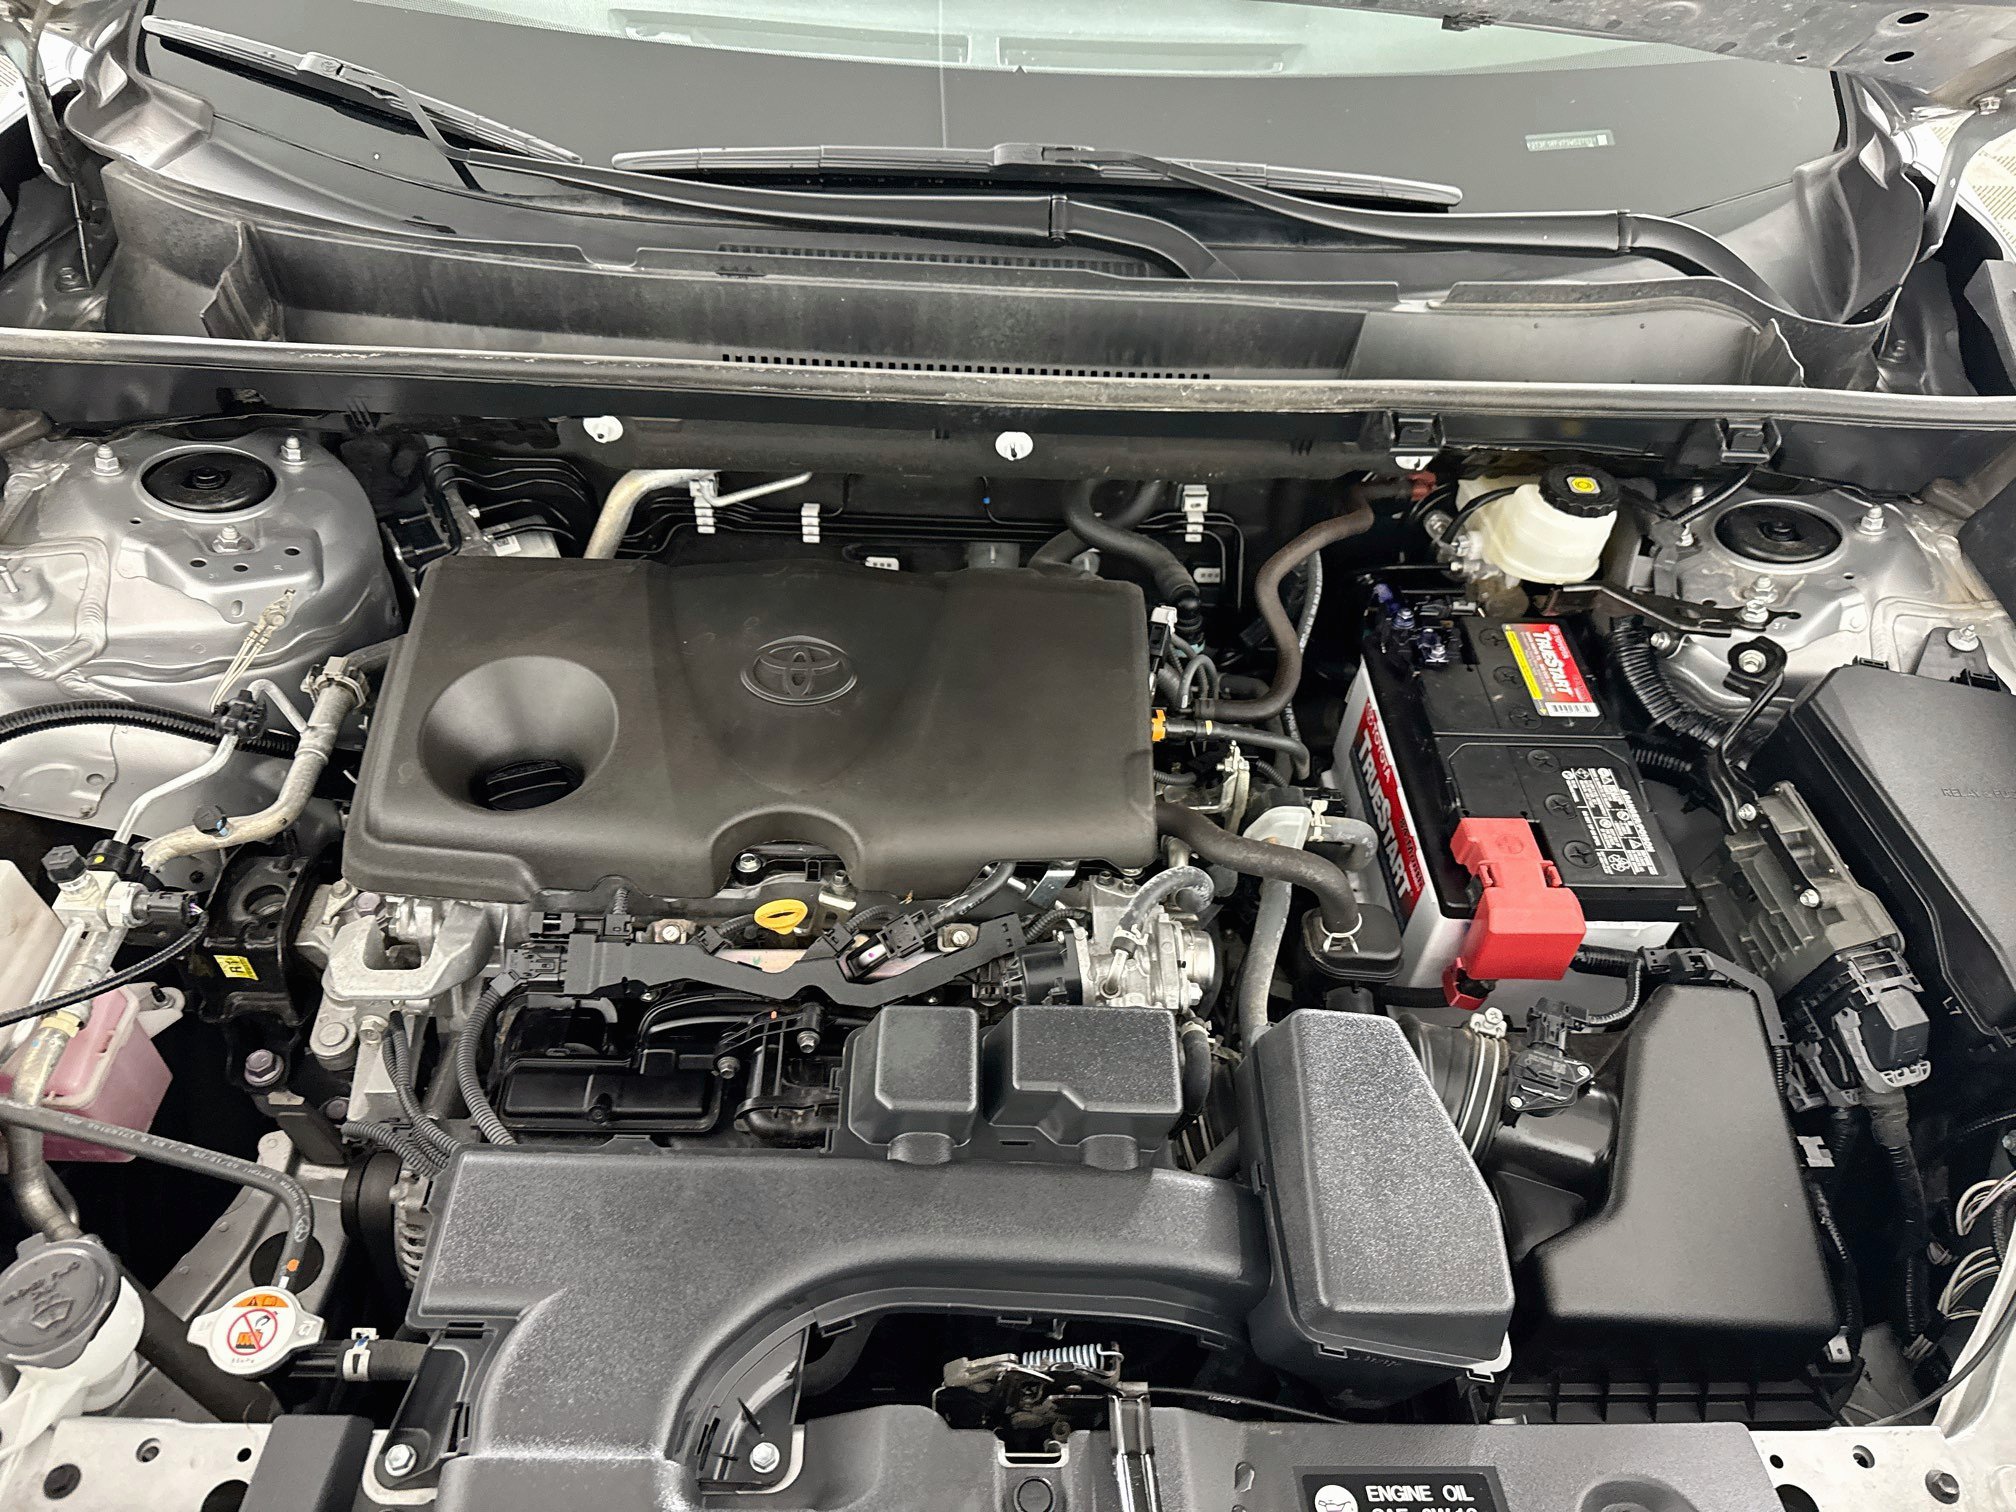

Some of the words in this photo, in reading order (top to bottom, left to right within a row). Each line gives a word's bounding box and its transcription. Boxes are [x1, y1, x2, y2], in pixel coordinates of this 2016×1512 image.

[1554, 635, 1570, 659] TOYOTA
[1940, 787, 1981, 798] RELAY
[1358, 727, 1412, 898] TRUESTART
[1365, 1485, 1434, 1502] ENGINE
[1442, 1485, 1475, 1502] OIL
